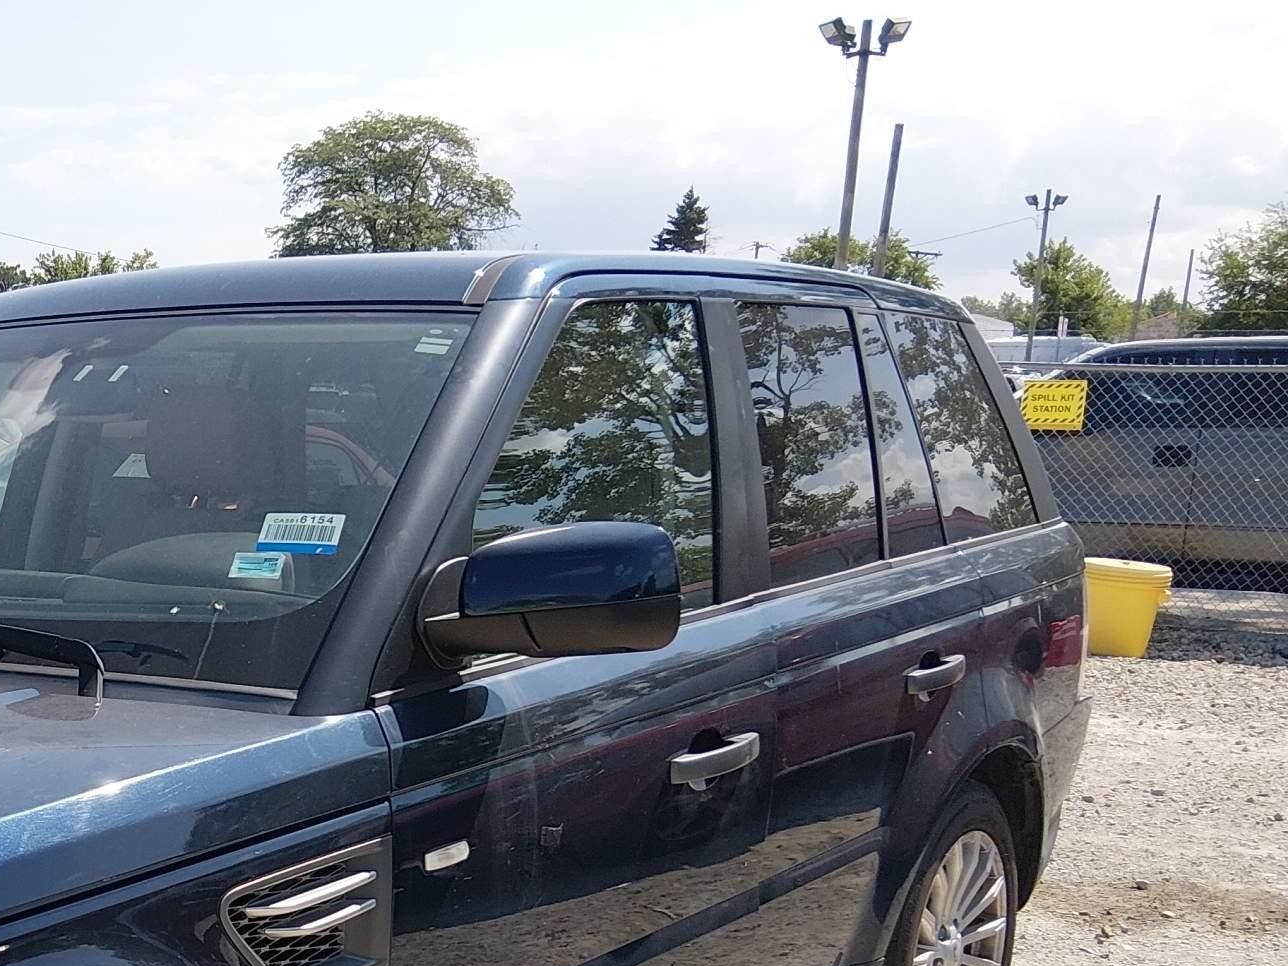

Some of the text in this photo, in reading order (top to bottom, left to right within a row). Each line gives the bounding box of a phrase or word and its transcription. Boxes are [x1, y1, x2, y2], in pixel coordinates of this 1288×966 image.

[1031, 393, 1075, 402] SPILL KIT
[1032, 404, 1071, 413] STATION
